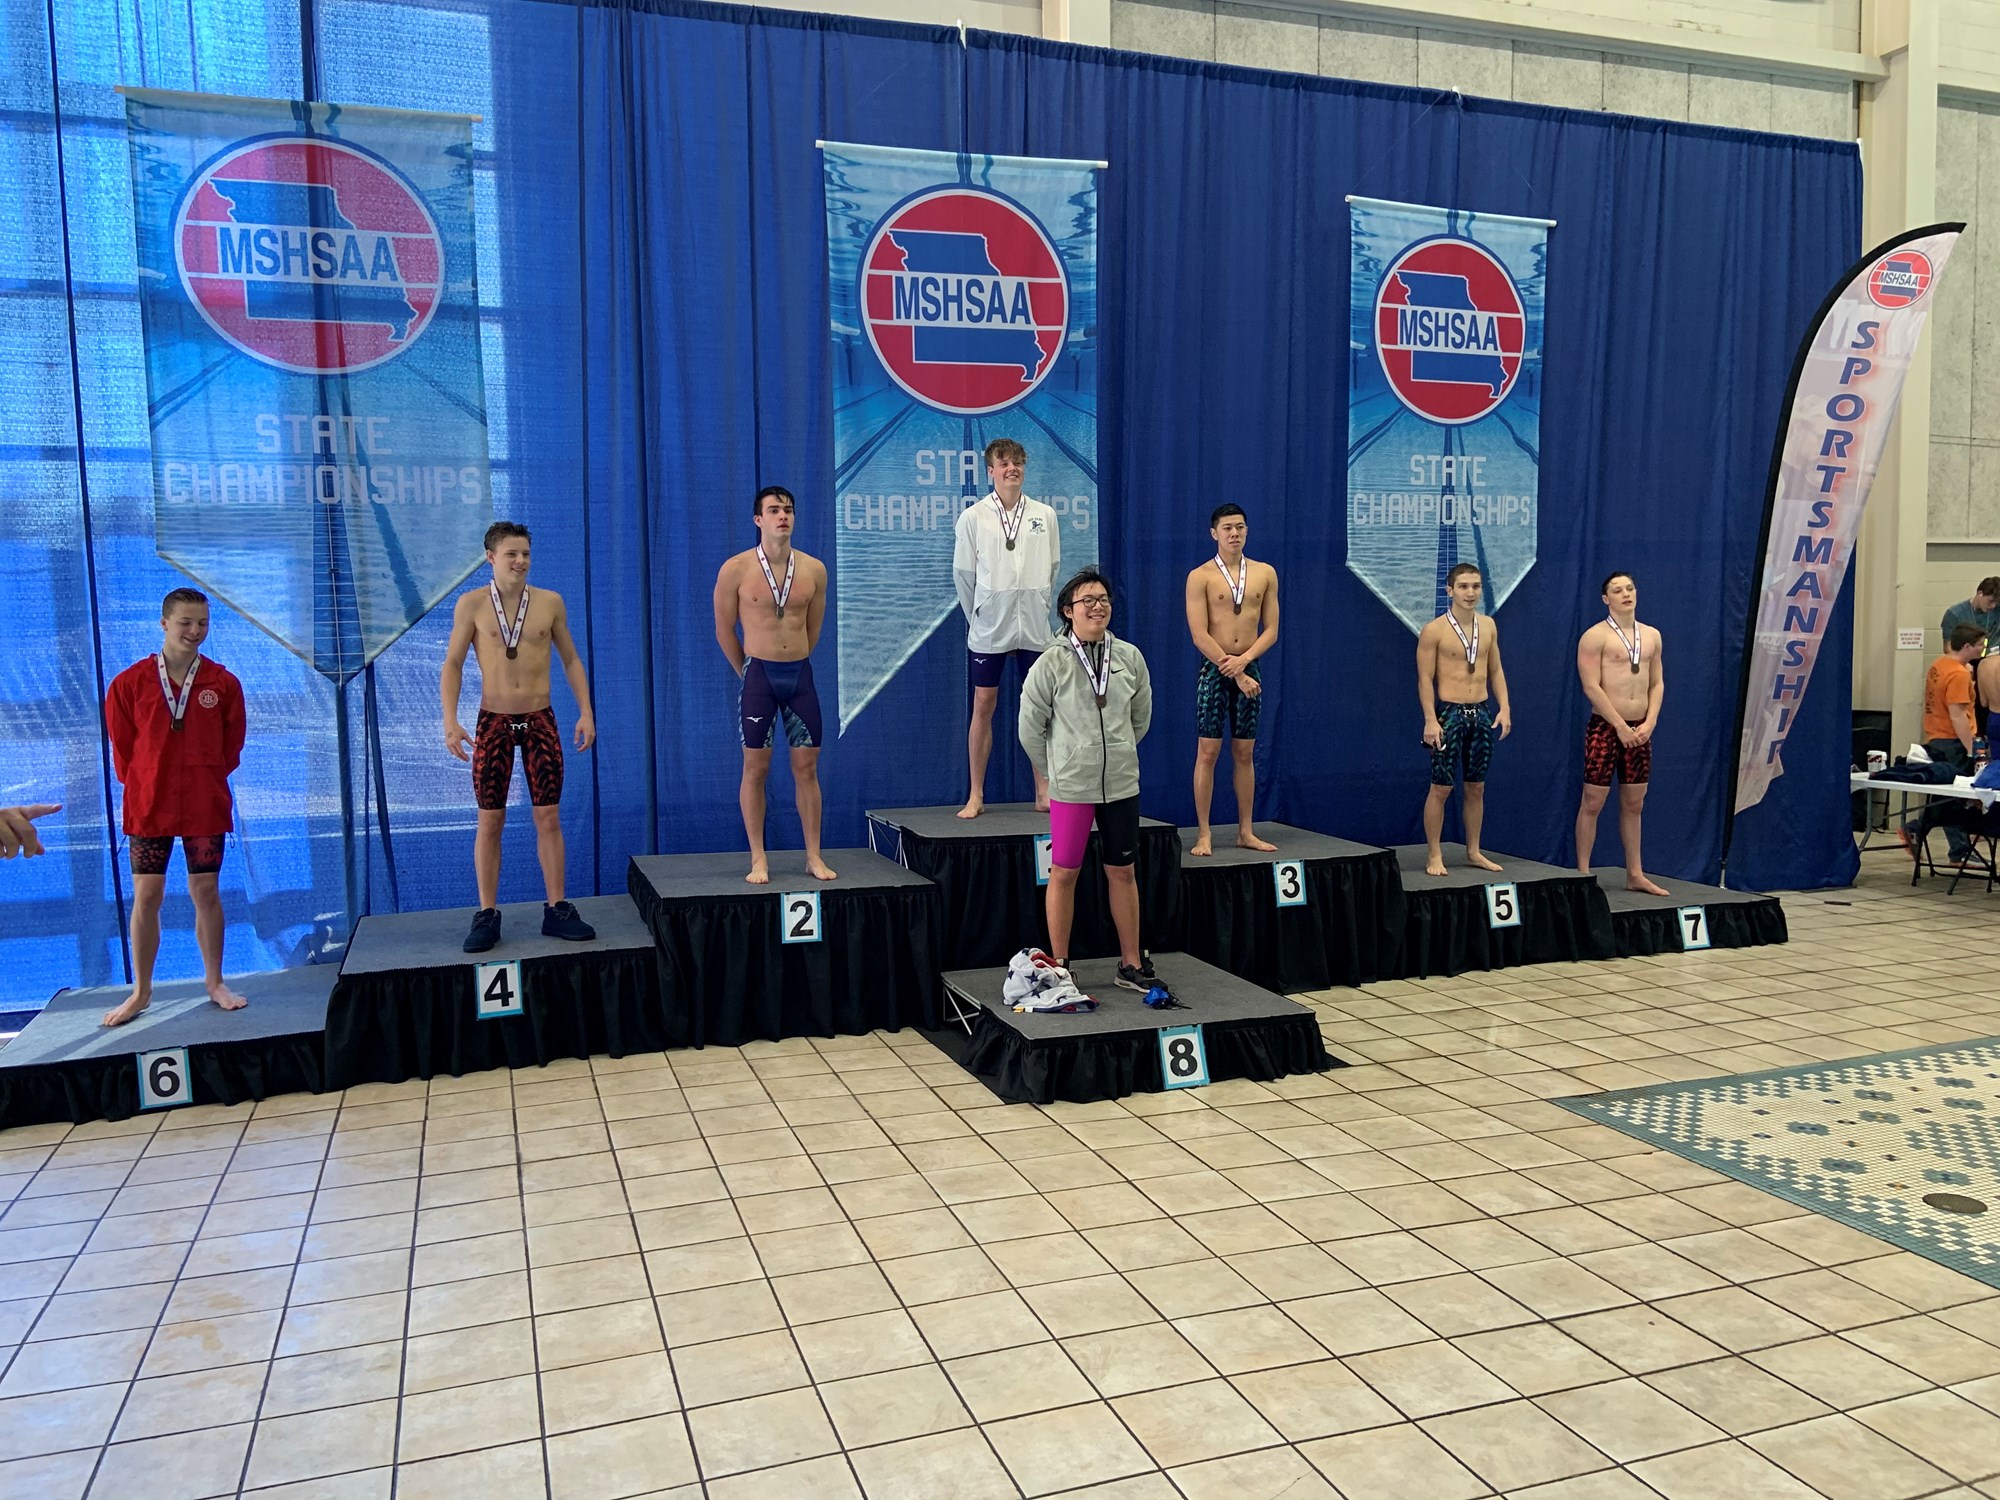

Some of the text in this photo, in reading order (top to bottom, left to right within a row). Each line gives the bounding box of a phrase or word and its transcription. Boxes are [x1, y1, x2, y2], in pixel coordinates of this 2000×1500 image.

[219, 227, 398, 281] MSHSAA
[1879, 271, 1919, 287] MSHSAA
[895, 276, 1031, 325] MSHSAA
[1399, 309, 1499, 351] MSHSAA
[255, 413, 392, 455] STATE
[164, 462, 483, 505] CHAMPIONSHIPS
[916, 450, 994, 486] STA
[1410, 454, 1487, 487] STATE
[1353, 493, 1531, 526] CHAMPIONSHIPS
[510, 722, 528, 731] TYR
[1280, 865, 1300, 899] 3
[789, 900, 814, 938] 2
[1495, 889, 1513, 921] 5
[1684, 913, 1702, 941] 7
[484, 967, 514, 1007] 4
[1168, 1037, 1198, 1077] 8
[149, 1055, 180, 1098] 6
